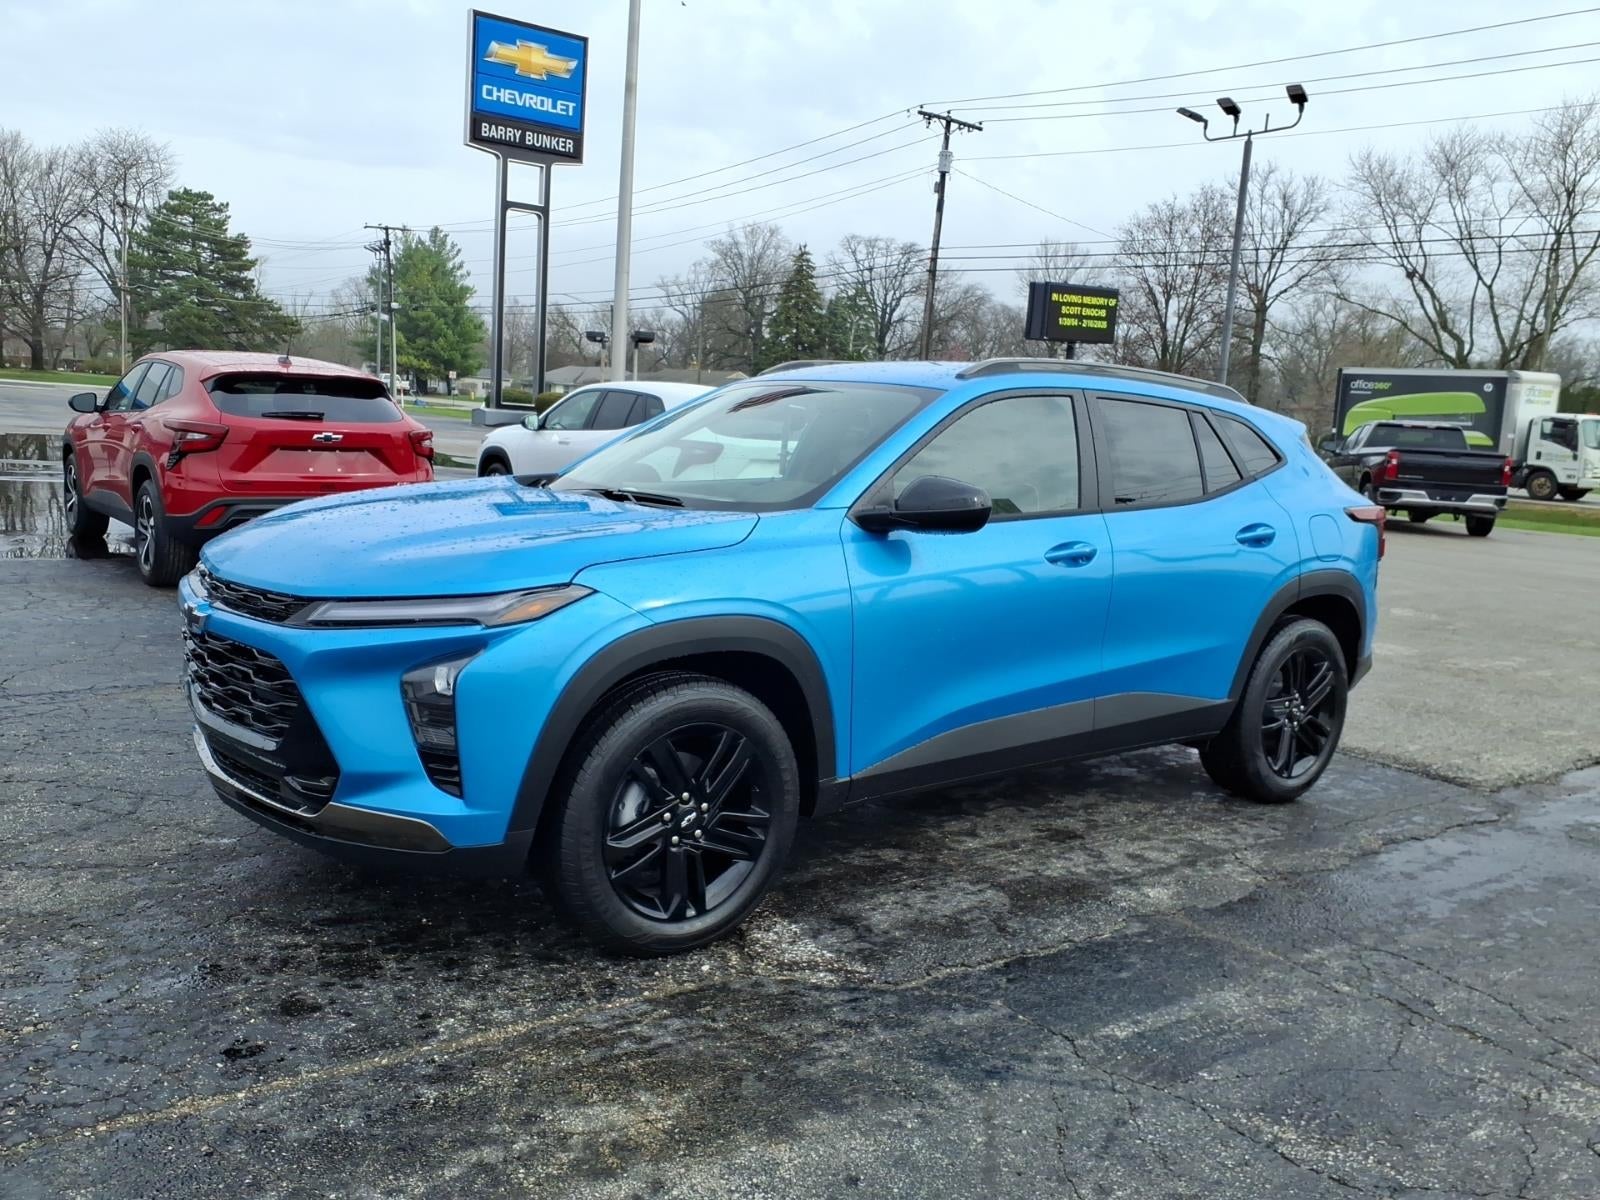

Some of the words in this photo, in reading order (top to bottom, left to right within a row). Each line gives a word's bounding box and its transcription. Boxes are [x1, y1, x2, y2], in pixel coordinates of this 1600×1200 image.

[482, 84, 576, 116] CHEVROLET
[481, 123, 522, 143] BARRY
[526, 131, 574, 153] BUNKER
[1051, 293, 1058, 301] IN
[1059, 294, 1082, 304] LOVING
[1083, 296, 1108, 306] MEMORY
[1061, 306, 1081, 314] SCOTT
[1082, 308, 1106, 317] ENOCHS
